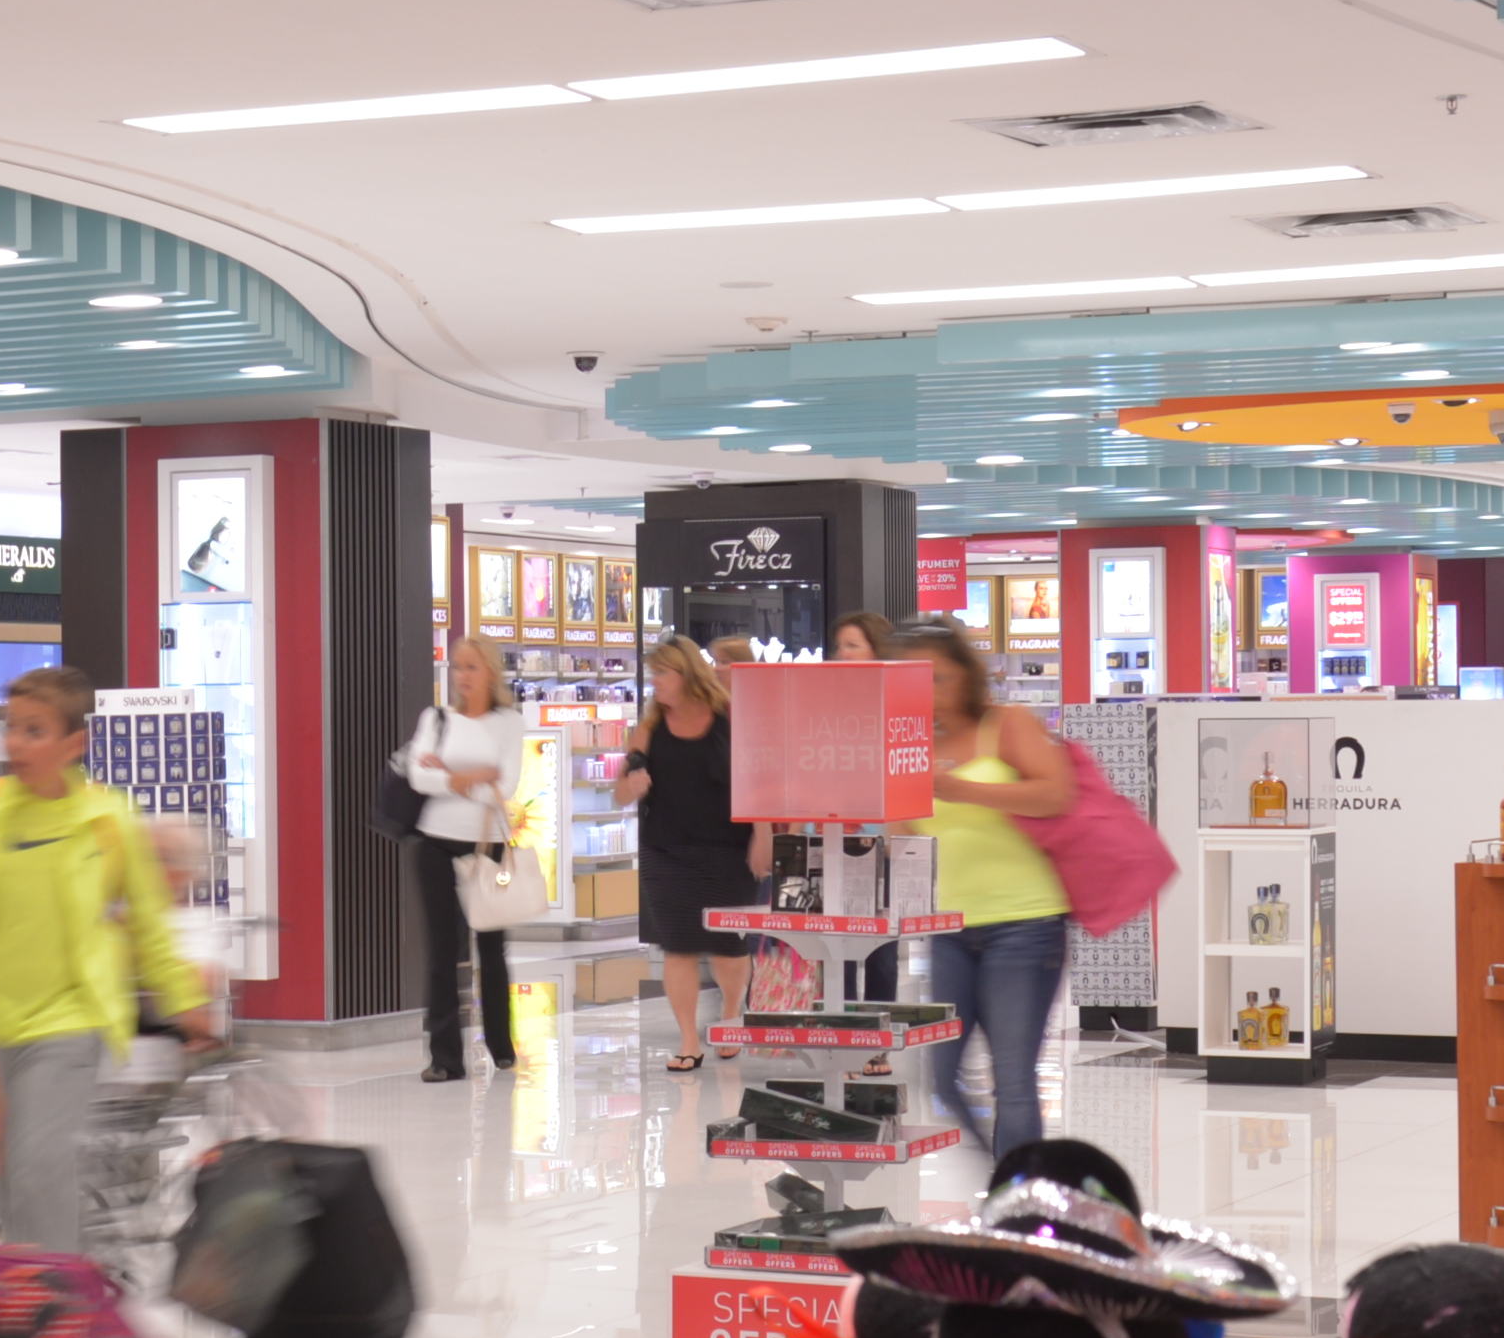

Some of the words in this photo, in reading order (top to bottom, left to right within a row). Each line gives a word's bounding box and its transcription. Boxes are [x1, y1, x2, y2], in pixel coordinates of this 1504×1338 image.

[916, 559, 961, 569] RFUMERY
[937, 572, 956, 583] 20%
[1330, 588, 1363, 596] SPECIAL
[1010, 639, 1060, 650] FRAGRANC
[123, 696, 178, 707] SWAROVSKI
[888, 716, 930, 743] SPECIAL
[888, 746, 930, 775] OFFERS
[1320, 785, 1373, 793] TEQUILA
[1293, 798, 1402, 810] HERRADURA
[720, 920, 750, 928] OFFERS
[762, 921, 792, 929] OFFERS
[804, 923, 835, 931] OFFERS
[847, 924, 878, 933] OFFERS
[722, 1034, 752, 1042] OFFERS
[764, 1035, 795, 1043] OFFERS
[807, 1036, 839, 1044] OFFERS
[850, 1037, 882, 1046] OFFERS
[725, 1148, 756, 1157] OFFERS
[768, 1150, 799, 1158] OFFERS
[811, 1151, 843, 1159] OFFERS
[854, 1152, 887, 1160] OFFERS
[723, 1258, 753, 1267] OFFERS
[765, 1260, 796, 1269] OFFERS
[808, 1263, 839, 1272] OFFERS
[713, 1291, 841, 1329] SPECIA
